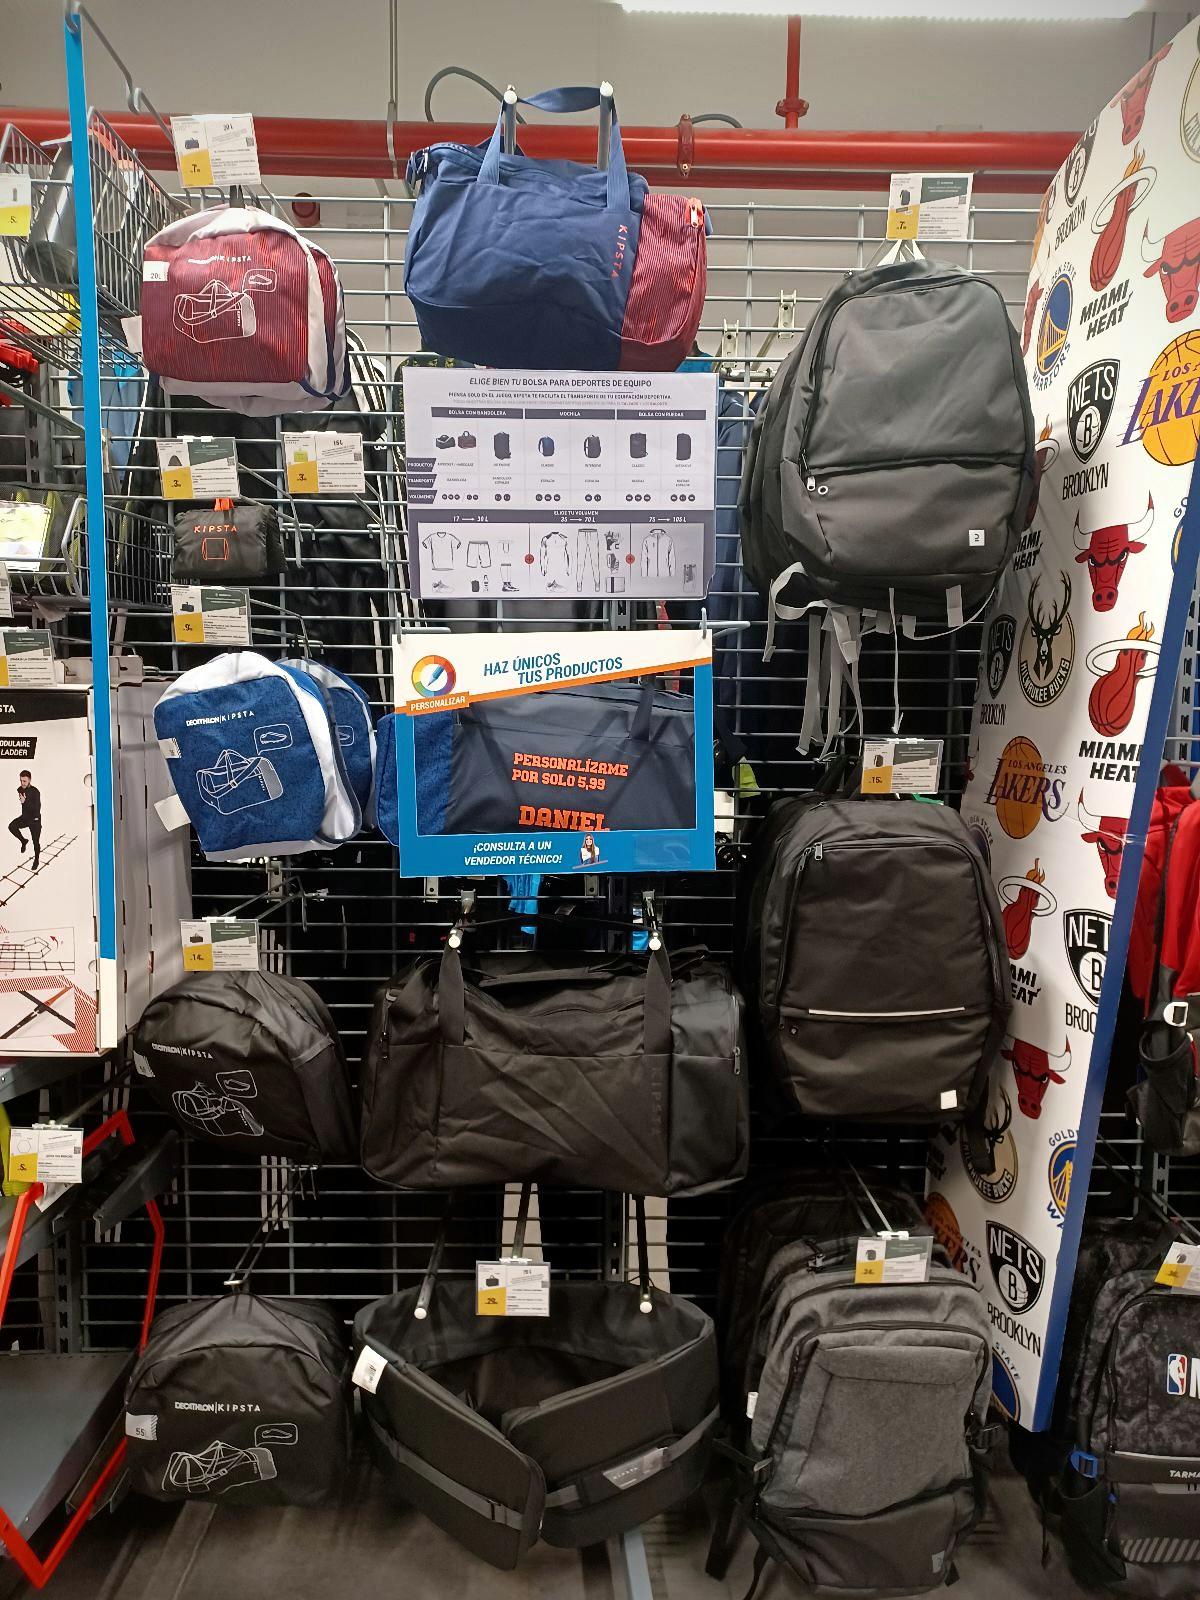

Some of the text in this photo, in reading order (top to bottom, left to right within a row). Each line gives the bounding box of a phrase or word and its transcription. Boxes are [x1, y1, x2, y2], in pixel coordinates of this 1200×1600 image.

[1054, 196, 1088, 251] BROOKLYN
[610, 223, 629, 279] KIPSTA
[1079, 279, 1130, 326] MIAMI
[1086, 298, 1132, 341] HEAT
[1032, 341, 1071, 391] WARRIORS
[1162, 362, 1192, 382] LOS
[469, 377, 652, 389] ELIGE BIEN TU BOLSA PARA DEPORTES DE EQUIPO
[1069, 364, 1115, 418] NETS
[1062, 462, 1109, 501] BROOKLYN
[193, 524, 239, 533] KIPSTA
[483, 652, 561, 677] HAZ ÚNICOS
[518, 656, 623, 685] TUS PRODUCTOS
[1020, 660, 1070, 702] MILWAUKEE BUCKS
[410, 695, 466, 711] PERSONALIZAR
[980, 703, 1007, 725] BROOKLYN
[185, 710, 255, 727] DECATHLON KIPSTA
[0, 740, 31, 748] ODULAIRE
[513, 752, 629, 777] PERSONALÍZAME
[1008, 759, 1068, 775] LOS ANGELES
[512, 768, 606, 791] POR SOLO 5,99
[984, 757, 1070, 822] LAKERS
[518, 805, 611, 832] DANIEL
[464, 852, 562, 866] VENDEDOR TÉCNICO!
[473, 841, 552, 853] ¡CONSULTA A UN
[1069, 914, 1113, 952] NET
[1010, 982, 1041, 1006] EAT
[1065, 1002, 1098, 1035] BROO
[1048, 1128, 1079, 1147] GOLD
[989, 1226, 1040, 1284] NETS
[987, 1302, 1041, 1358] BROOKLYN
[174, 1401, 261, 1413] DECATHLON KIPSTA
[1169, 1469, 1200, 1479] TARMA
